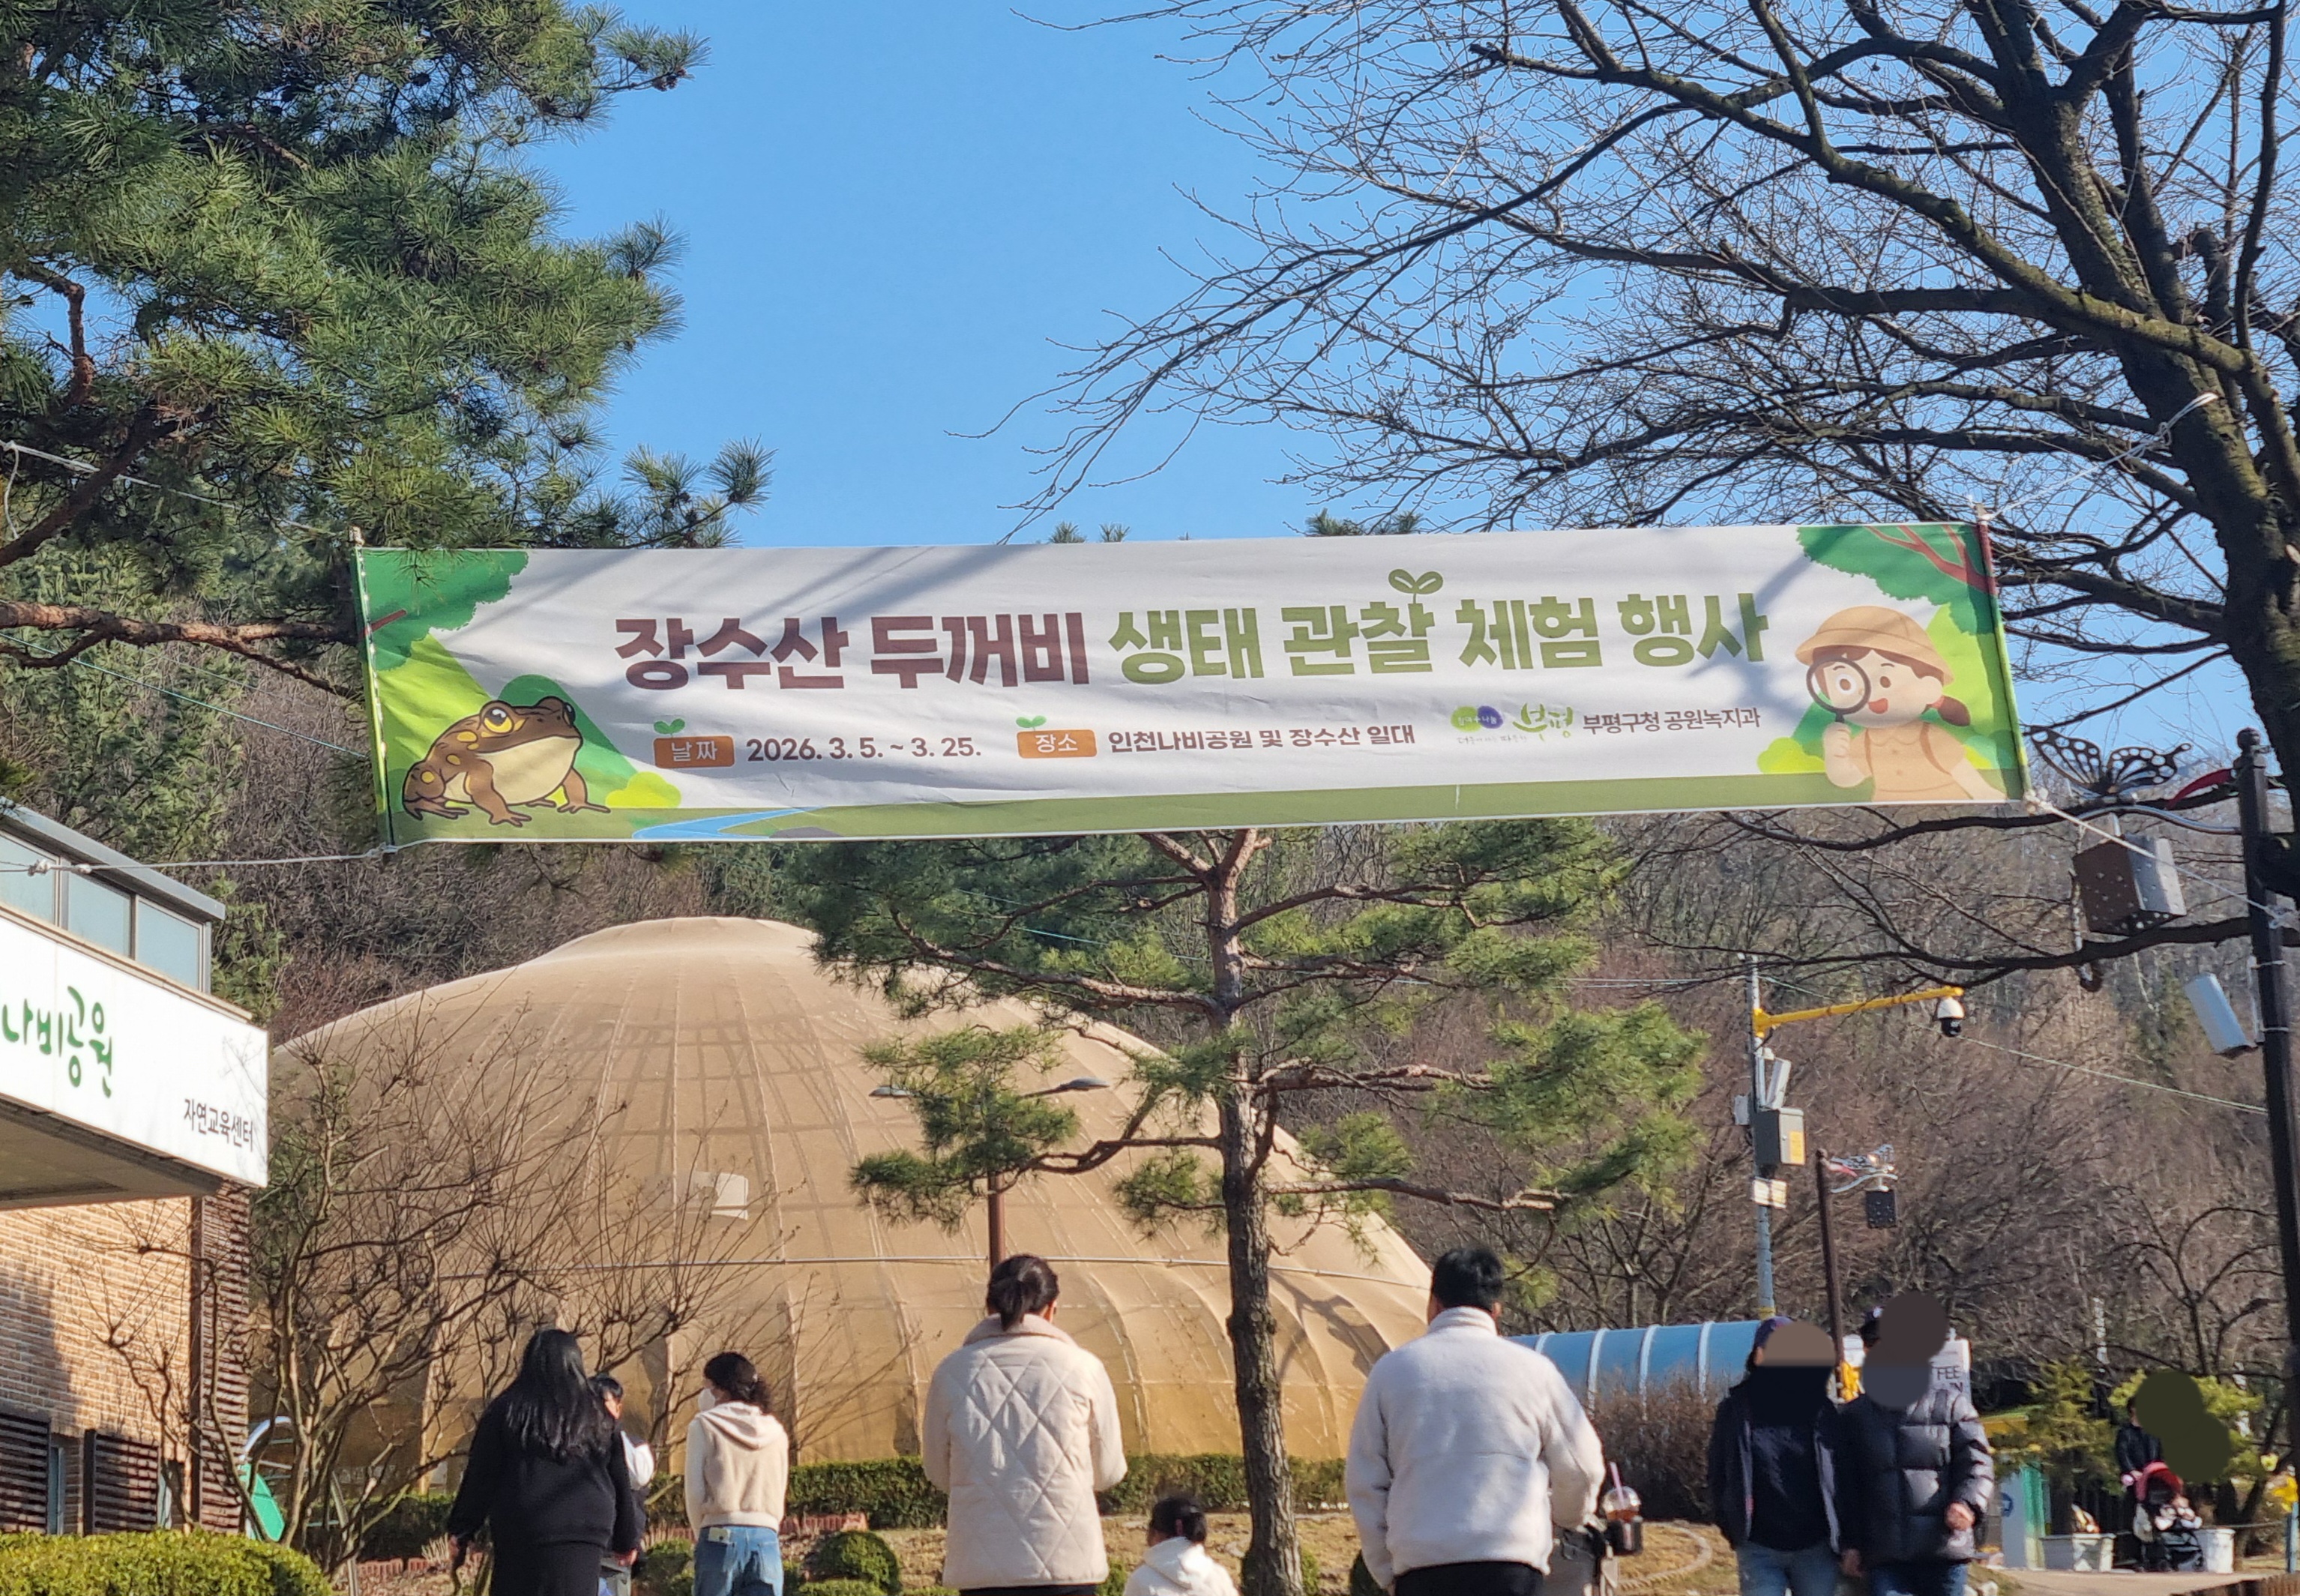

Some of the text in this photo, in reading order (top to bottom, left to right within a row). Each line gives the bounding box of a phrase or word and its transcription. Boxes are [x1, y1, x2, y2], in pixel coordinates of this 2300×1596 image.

[615, 593, 1769, 690] 장수산 두꺼비 생태 관찰 체험 행사
[1583, 707, 1761, 735] 부평구청 공원녹지과
[671, 739, 718, 762] 날짜
[1035, 733, 1079, 753] 장소
[1107, 723, 1415, 753] 인천나비공원 및 장수산 일대
[1, 985, 112, 1098] 나비공원
[184, 1098, 253, 1152] 자연교육센터
